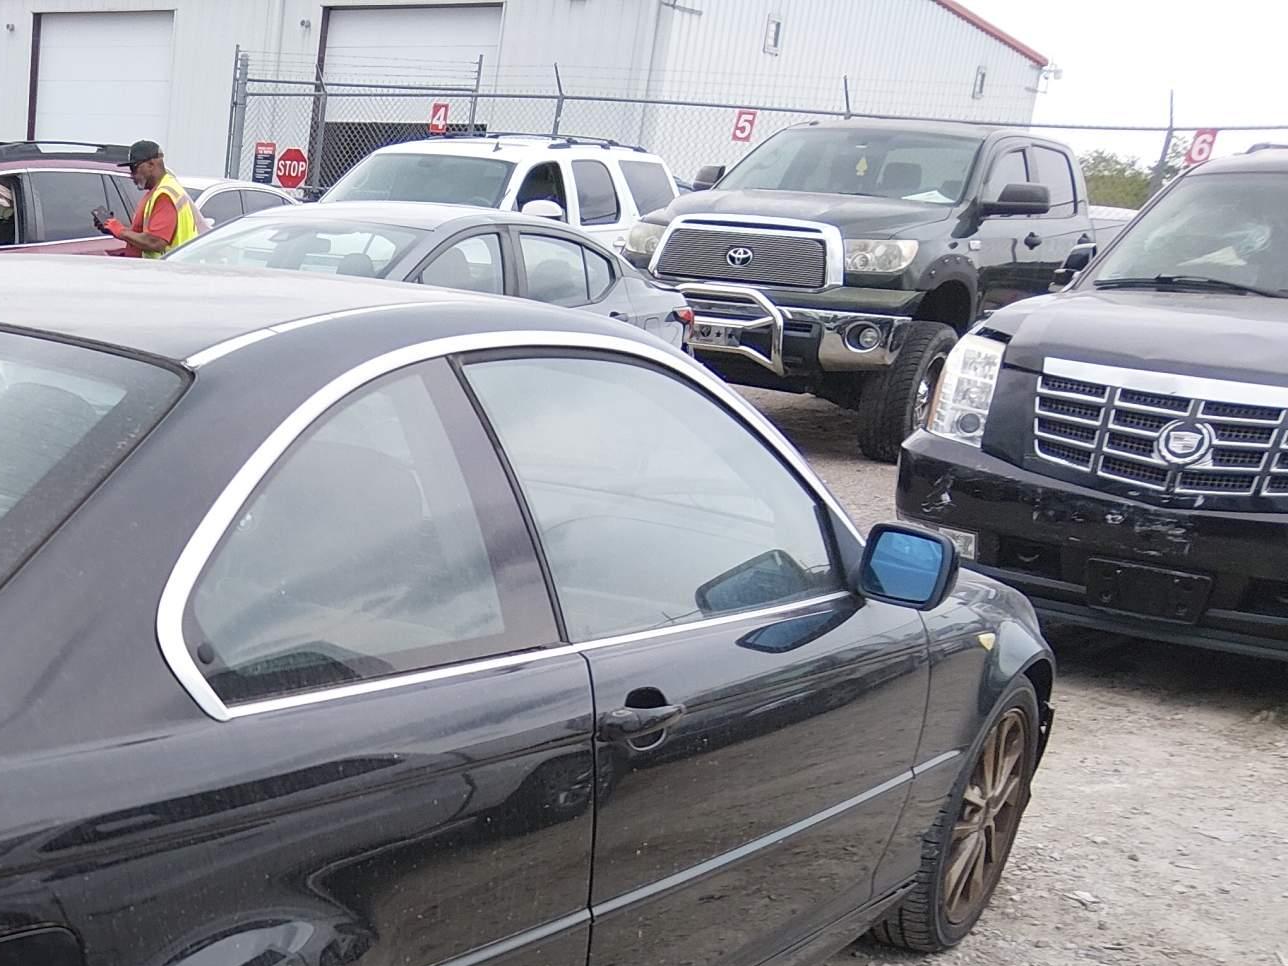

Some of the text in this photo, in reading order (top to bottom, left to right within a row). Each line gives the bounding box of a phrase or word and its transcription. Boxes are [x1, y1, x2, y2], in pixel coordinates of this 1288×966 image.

[432, 106, 446, 130] 4
[735, 114, 754, 138] 5
[1192, 134, 1213, 161] 6
[278, 160, 307, 177] STOP
